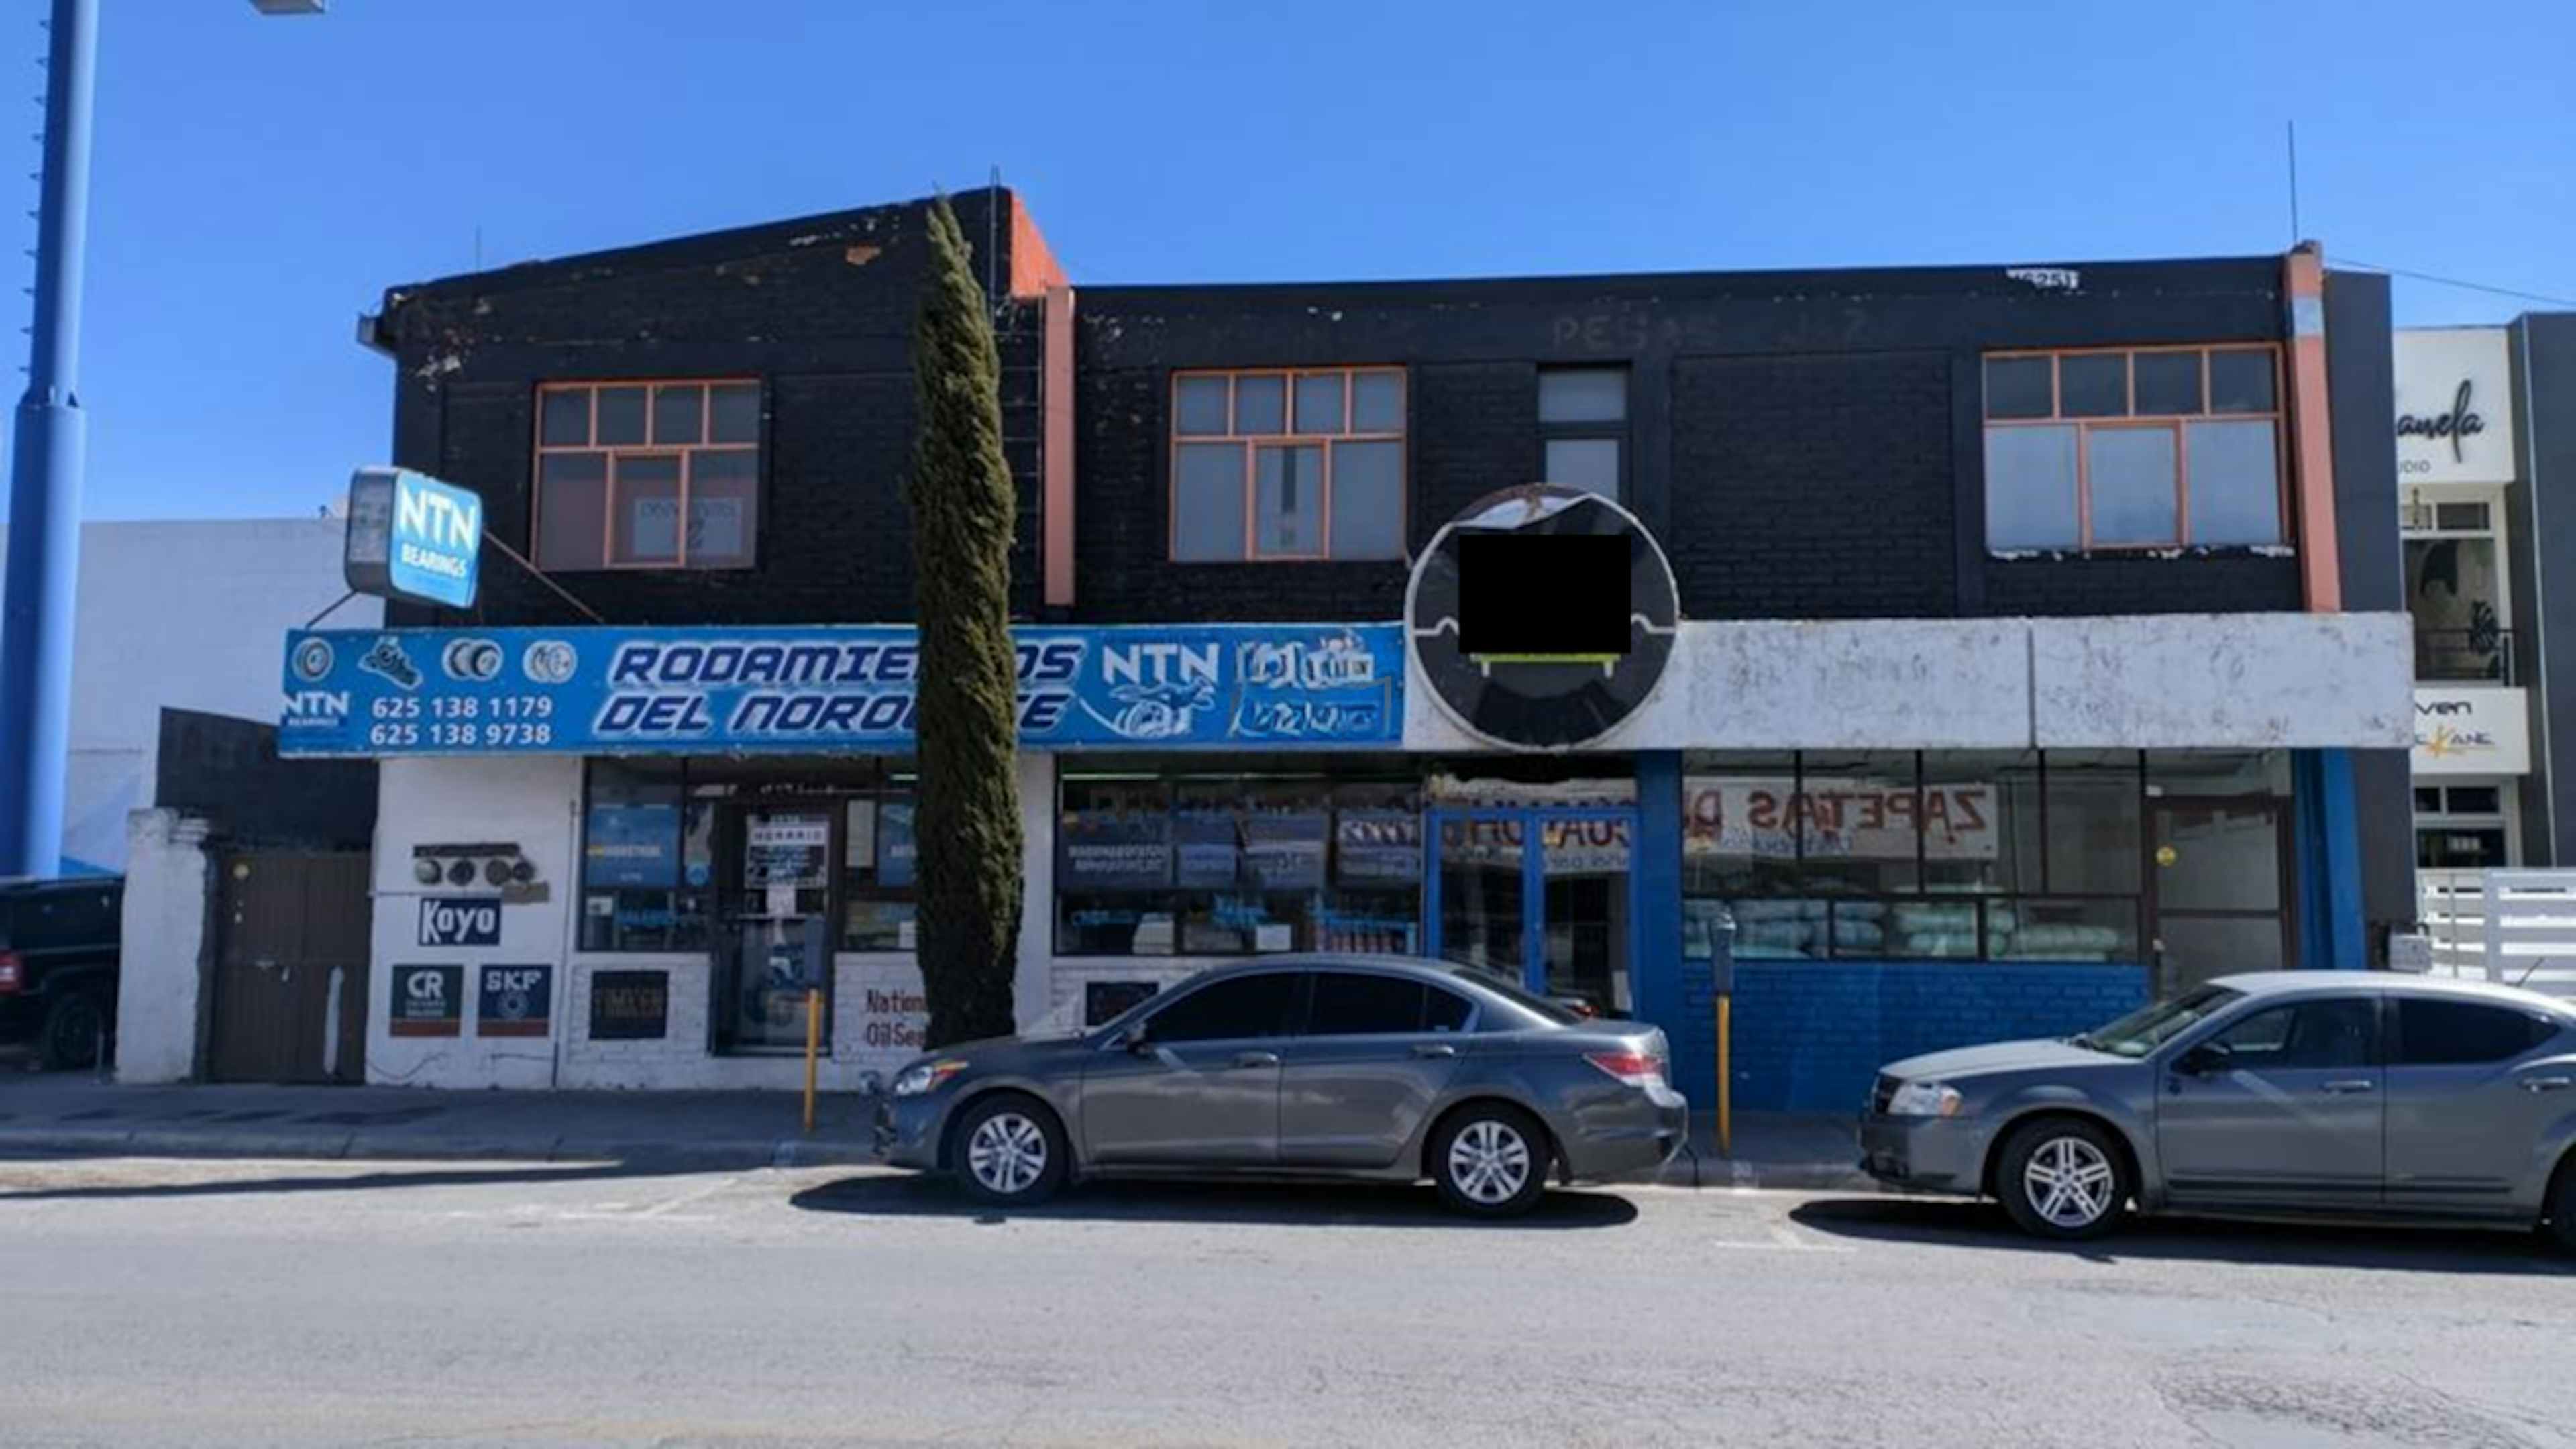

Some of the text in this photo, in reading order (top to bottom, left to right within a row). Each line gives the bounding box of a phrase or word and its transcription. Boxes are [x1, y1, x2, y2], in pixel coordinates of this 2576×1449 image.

[2400, 460, 2431, 474] DIO
[400, 486, 476, 551] NTN
[402, 543, 467, 578] BEARINGS
[612, 644, 1080, 684] RODAMIEOS
[1102, 643, 1220, 685] NTN
[282, 691, 351, 716] NTN
[372, 697, 553, 718] 625 138 1179
[596, 694, 1071, 731] DEL NOROE
[2415, 702, 2472, 715] ven
[370, 724, 419, 745] 625
[429, 724, 477, 745] 138
[486, 724, 551, 745] 9738
[406, 970, 445, 1000] CR
[486, 971, 542, 991] SKF
[867, 989, 926, 1013] Nation
[894, 1022, 925, 1046] Sea
